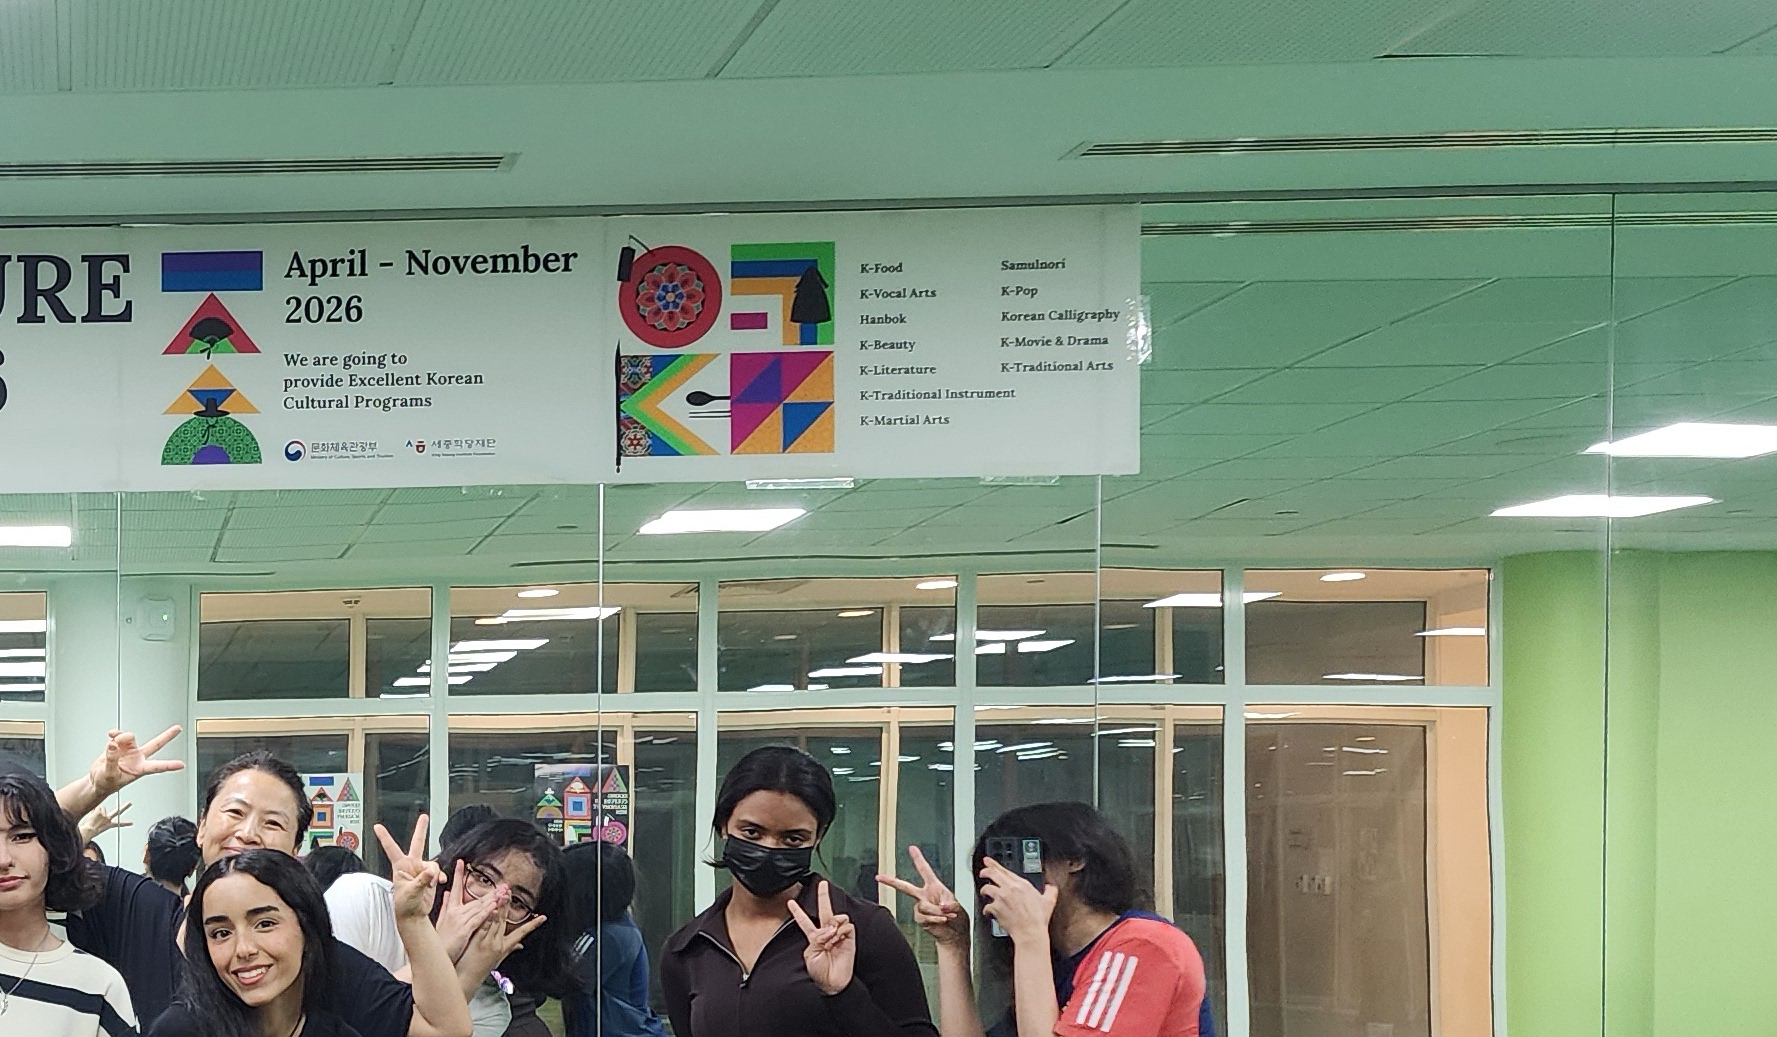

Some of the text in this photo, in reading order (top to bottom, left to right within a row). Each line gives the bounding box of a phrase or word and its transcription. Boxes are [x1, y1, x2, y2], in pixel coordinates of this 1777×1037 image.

[284, 249, 368, 286] April
[405, 245, 578, 276] November
[860, 262, 903, 274] K-Food
[1001, 258, 1066, 271] Samulnori
[860, 288, 937, 300] K-Vocal Arts
[1001, 286, 1038, 298] K-Pop
[285, 295, 363, 324] 2026
[1001, 309, 1120, 323] Korean Calligraphy
[859, 313, 907, 325] Hanbok
[859, 340, 916, 352] K-Beauty
[1000, 335, 1109, 348] K-Movie & Drama
[283, 351, 408, 370] We are going to
[1000, 361, 1114, 373] K-Traditional Arts
[859, 365, 937, 376] K-Literature
[283, 372, 484, 391] provide Excellent Korean
[859, 388, 1016, 401] K-Traditional Instrument
[283, 395, 432, 411] Cultural Programs
[860, 414, 950, 426] K-Martial Arts
